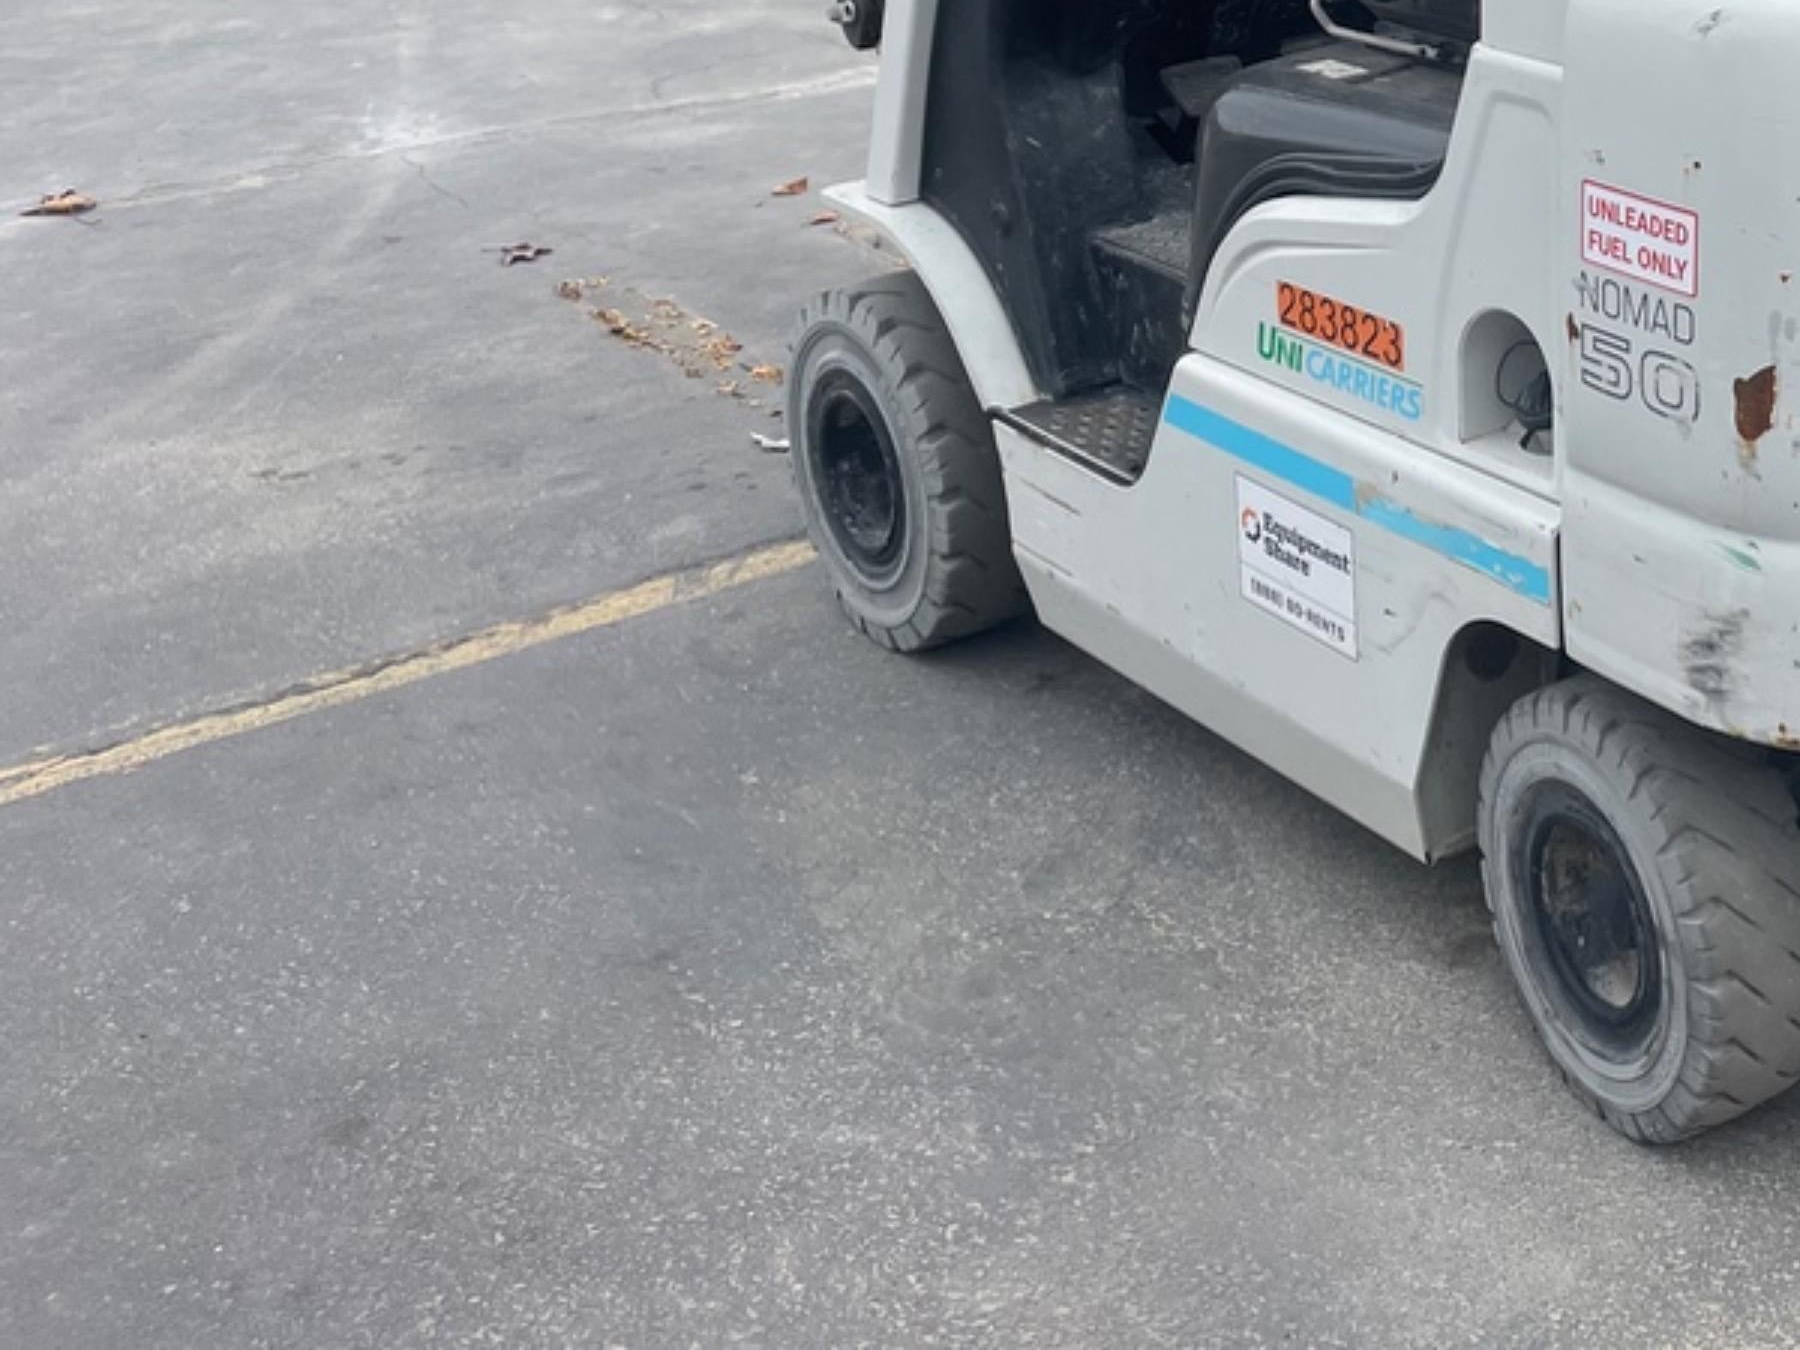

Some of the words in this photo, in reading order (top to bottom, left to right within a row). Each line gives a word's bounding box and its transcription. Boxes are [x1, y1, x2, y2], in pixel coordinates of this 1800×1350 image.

[1587, 229, 1632, 264] FUEL
[1636, 245, 1689, 282] ONLY
[1588, 194, 1690, 247] UNLEADED
[1278, 282, 1402, 368] 283823
[1577, 270, 1696, 346] NOMAD
[1580, 323, 1700, 423] 50
[1262, 511, 1351, 576] Equipment
